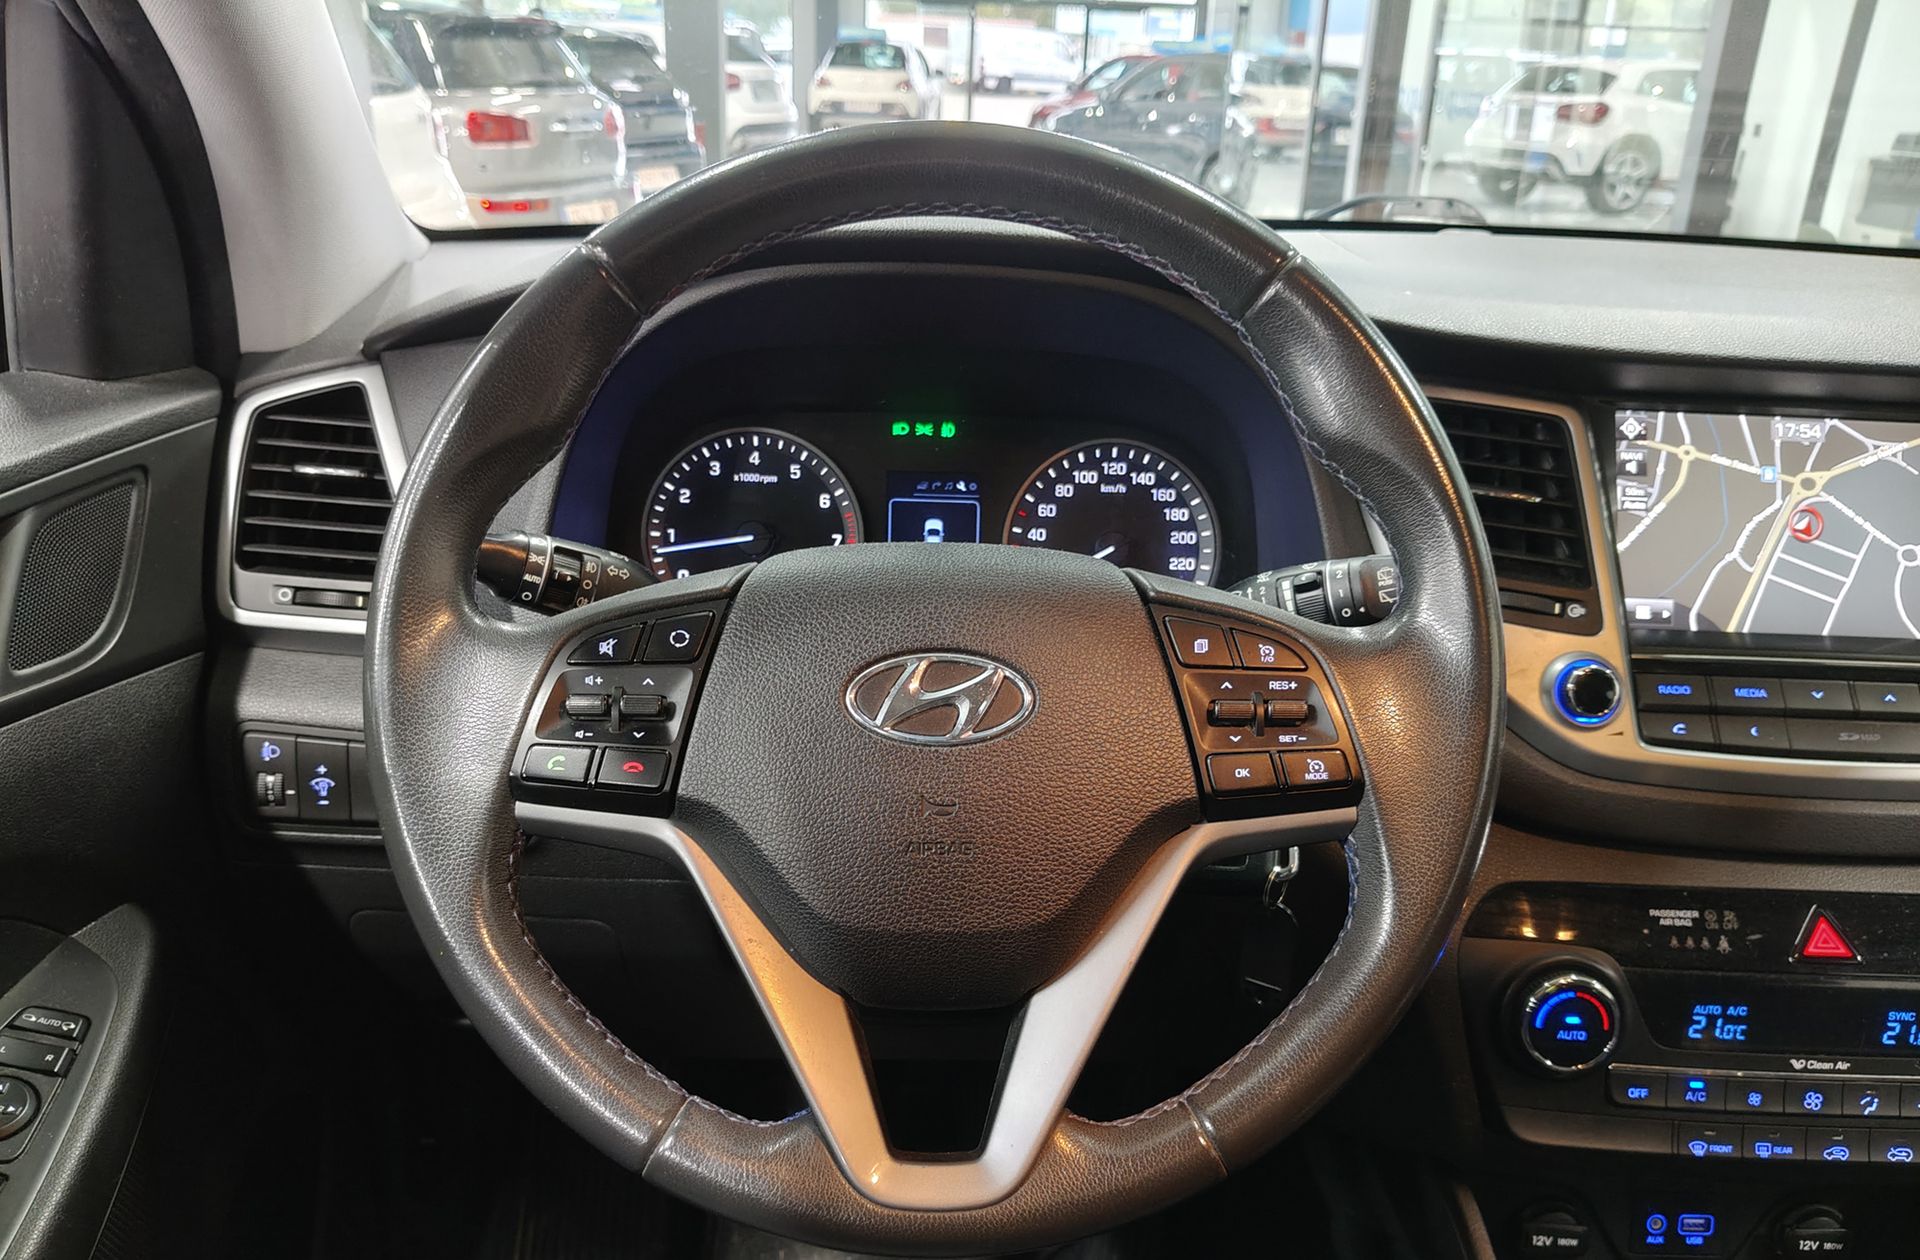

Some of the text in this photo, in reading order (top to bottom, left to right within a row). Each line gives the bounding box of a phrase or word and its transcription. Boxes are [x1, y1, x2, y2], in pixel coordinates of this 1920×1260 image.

[1774, 423, 1822, 438] 17:54
[750, 451, 760, 465] 4
[1620, 452, 1643, 461] NAVI
[709, 461, 721, 476] 3
[790, 464, 801, 479] 5
[1101, 462, 1127, 475] 120
[1072, 471, 1098, 484] 100
[1130, 472, 1156, 485] 140
[1055, 485, 1073, 497] 80
[1100, 484, 1127, 494] km/h
[679, 488, 691, 503] 2
[819, 493, 831, 508] 6
[1151, 489, 1177, 502] 160
[1038, 504, 1057, 517] 60
[1163, 508, 1189, 522] 180
[667, 528, 676, 543] 1
[1027, 528, 1047, 541] 40
[1170, 532, 1197, 545] 200
[831, 534, 843, 547] 7
[1169, 558, 1196, 571] 220
[523, 573, 542, 585] AUTO
[1336, 570, 1343, 579] 2
[1259, 586, 1266, 595] 2
[1338, 589, 1344, 598] 1
[1657, 685, 1692, 696] RADIO
[1734, 688, 1768, 698] MEDIA
[1235, 768, 1250, 777] OK
[1305, 773, 1329, 781] MODE
[1649, 909, 1700, 918] PASSENGER
[1693, 1004, 1748, 1016] AUTO A/C
[37, 1017, 61, 1026] AUTO
[1888, 1011, 1916, 1021] SYNC
[1557, 1030, 1588, 1041] AUTO
[1807, 1060, 1851, 1070] Clean Air
[1627, 1087, 1649, 1099] OFF
[1685, 1091, 1707, 1102] A/C
[1709, 1145, 1733, 1153] FRONT
[1773, 1146, 1793, 1154] REAR
[1532, 1235, 1553, 1246] 12V
[1646, 1236, 1664, 1245] AUX
[1686, 1236, 1704, 1245] USB
[1799, 1240, 1820, 1250] 12V
